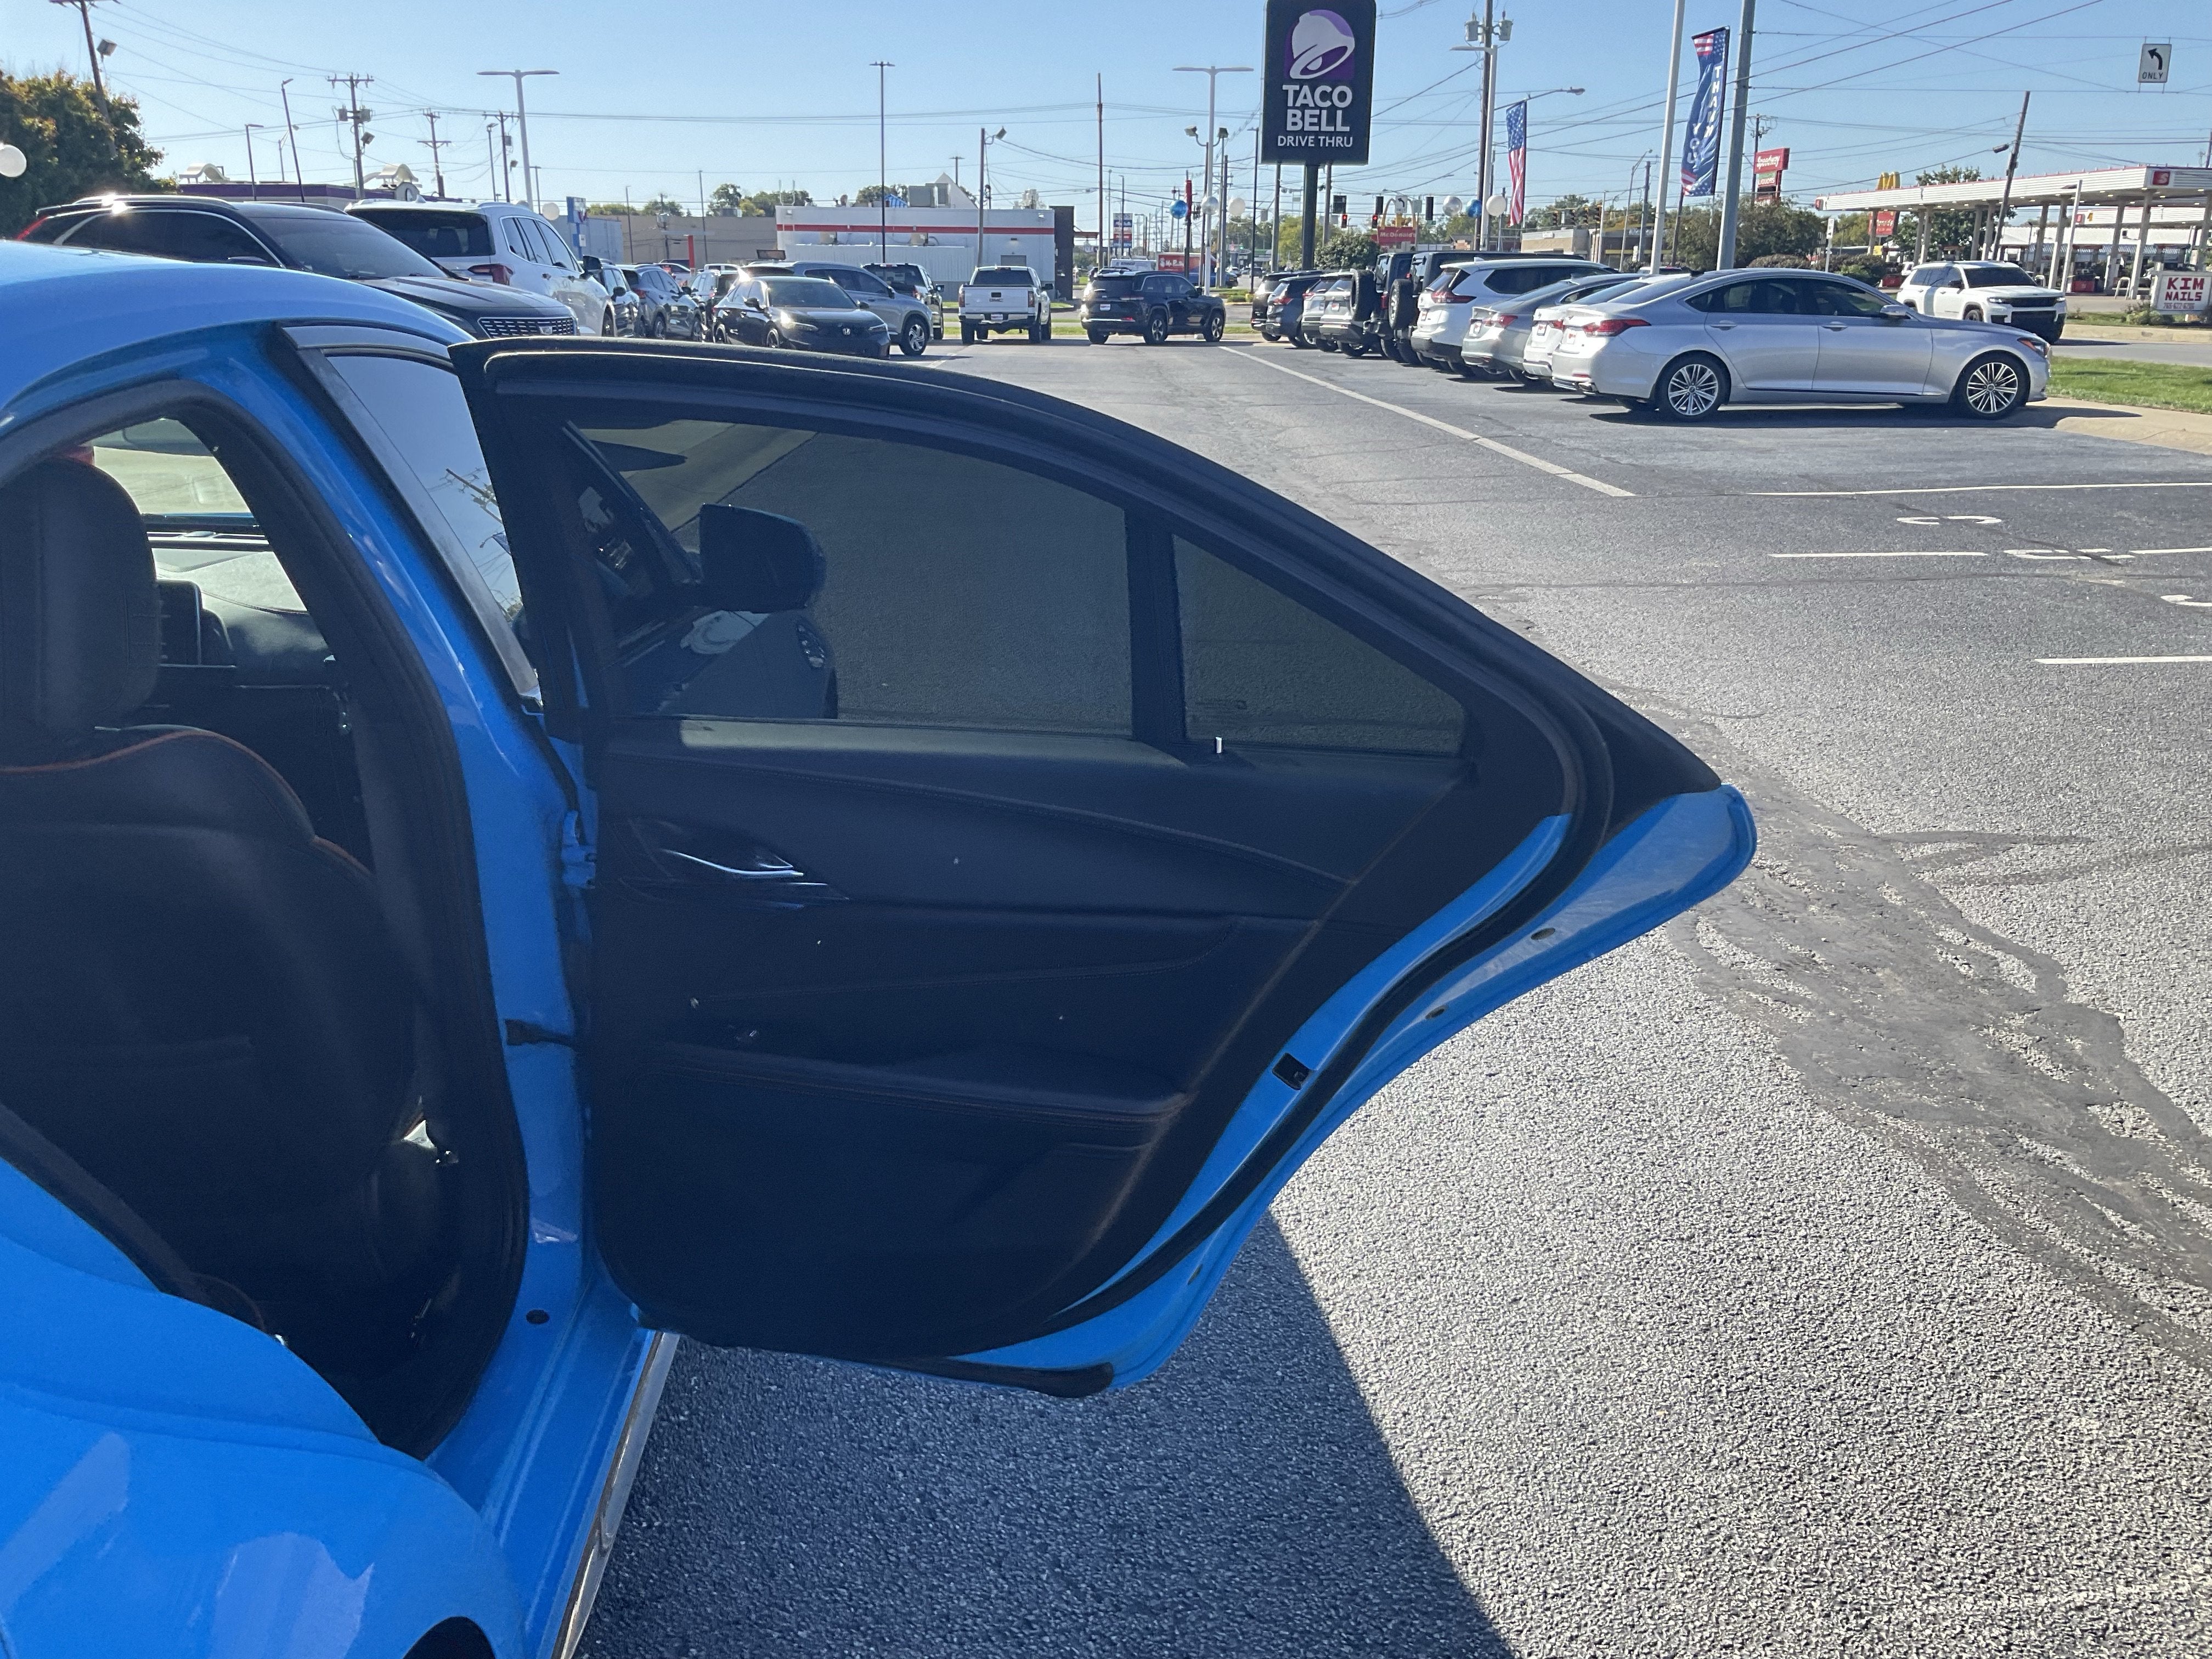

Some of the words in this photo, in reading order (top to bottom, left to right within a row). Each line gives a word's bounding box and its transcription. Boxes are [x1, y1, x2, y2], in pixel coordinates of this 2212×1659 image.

[1282, 84, 1352, 108] TACO
[1286, 109, 1350, 132] BELL
[1277, 135, 1315, 147] DRIVE
[1318, 136, 1353, 148] THRU
[1687, 122, 1701, 164] YOU
[2166, 277, 2204, 290] KIM
[2164, 291, 2203, 301] NAILS
